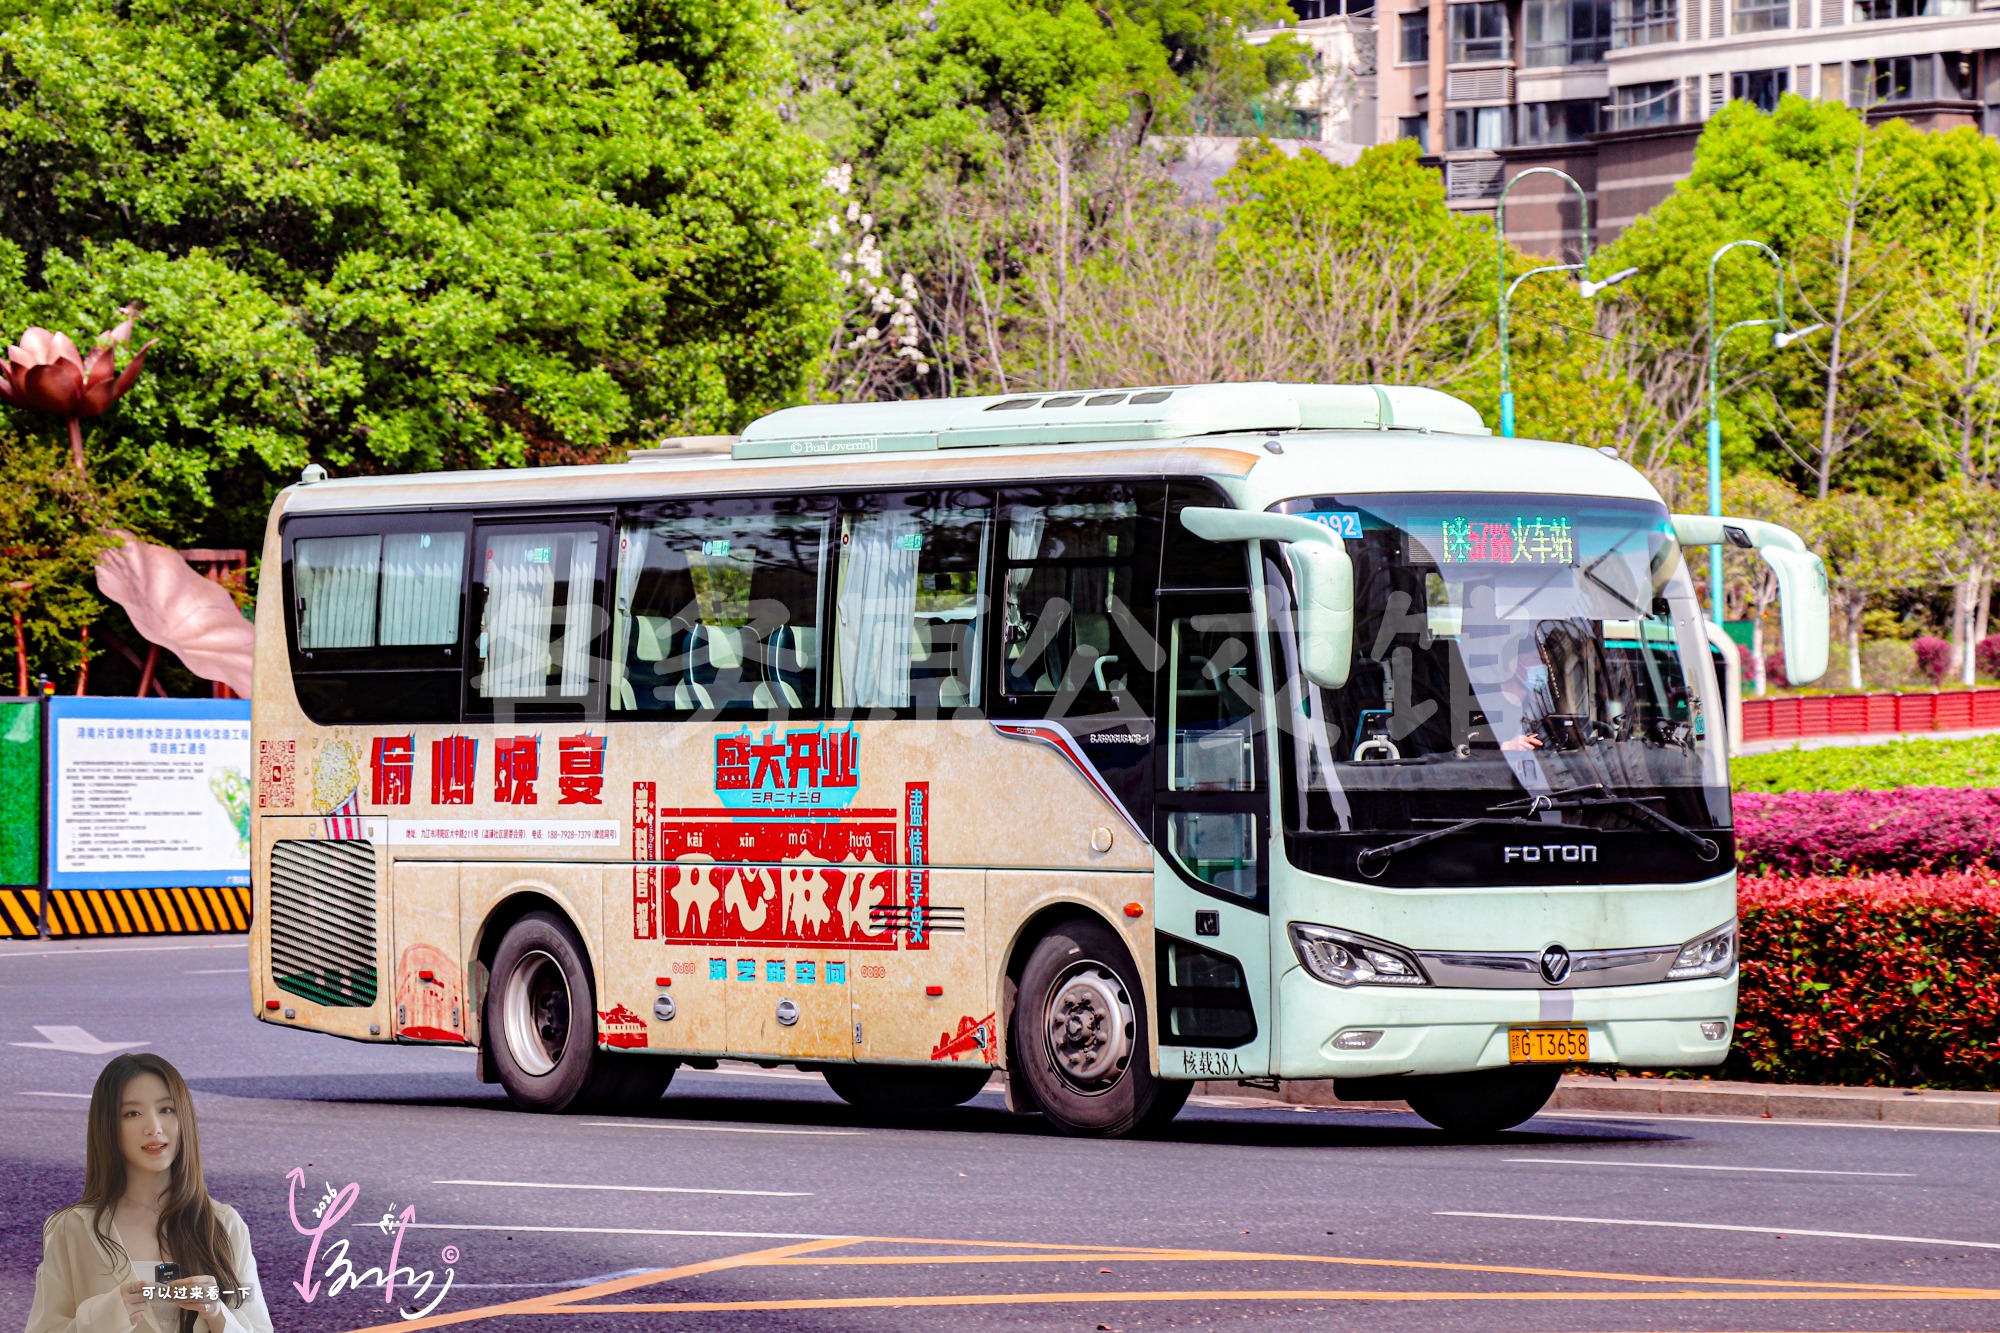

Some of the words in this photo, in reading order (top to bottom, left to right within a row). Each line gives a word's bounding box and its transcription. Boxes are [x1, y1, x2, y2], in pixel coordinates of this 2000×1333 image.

[715, 728, 858, 790] 盛大开业
[752, 791, 821, 804] 三月二十三日
[1504, 844, 1597, 863] FOTON
[670, 849, 897, 939] 开心麻花
[708, 958, 846, 985] 演艺新空间
[1183, 1050, 1244, 1075] 核载38人
